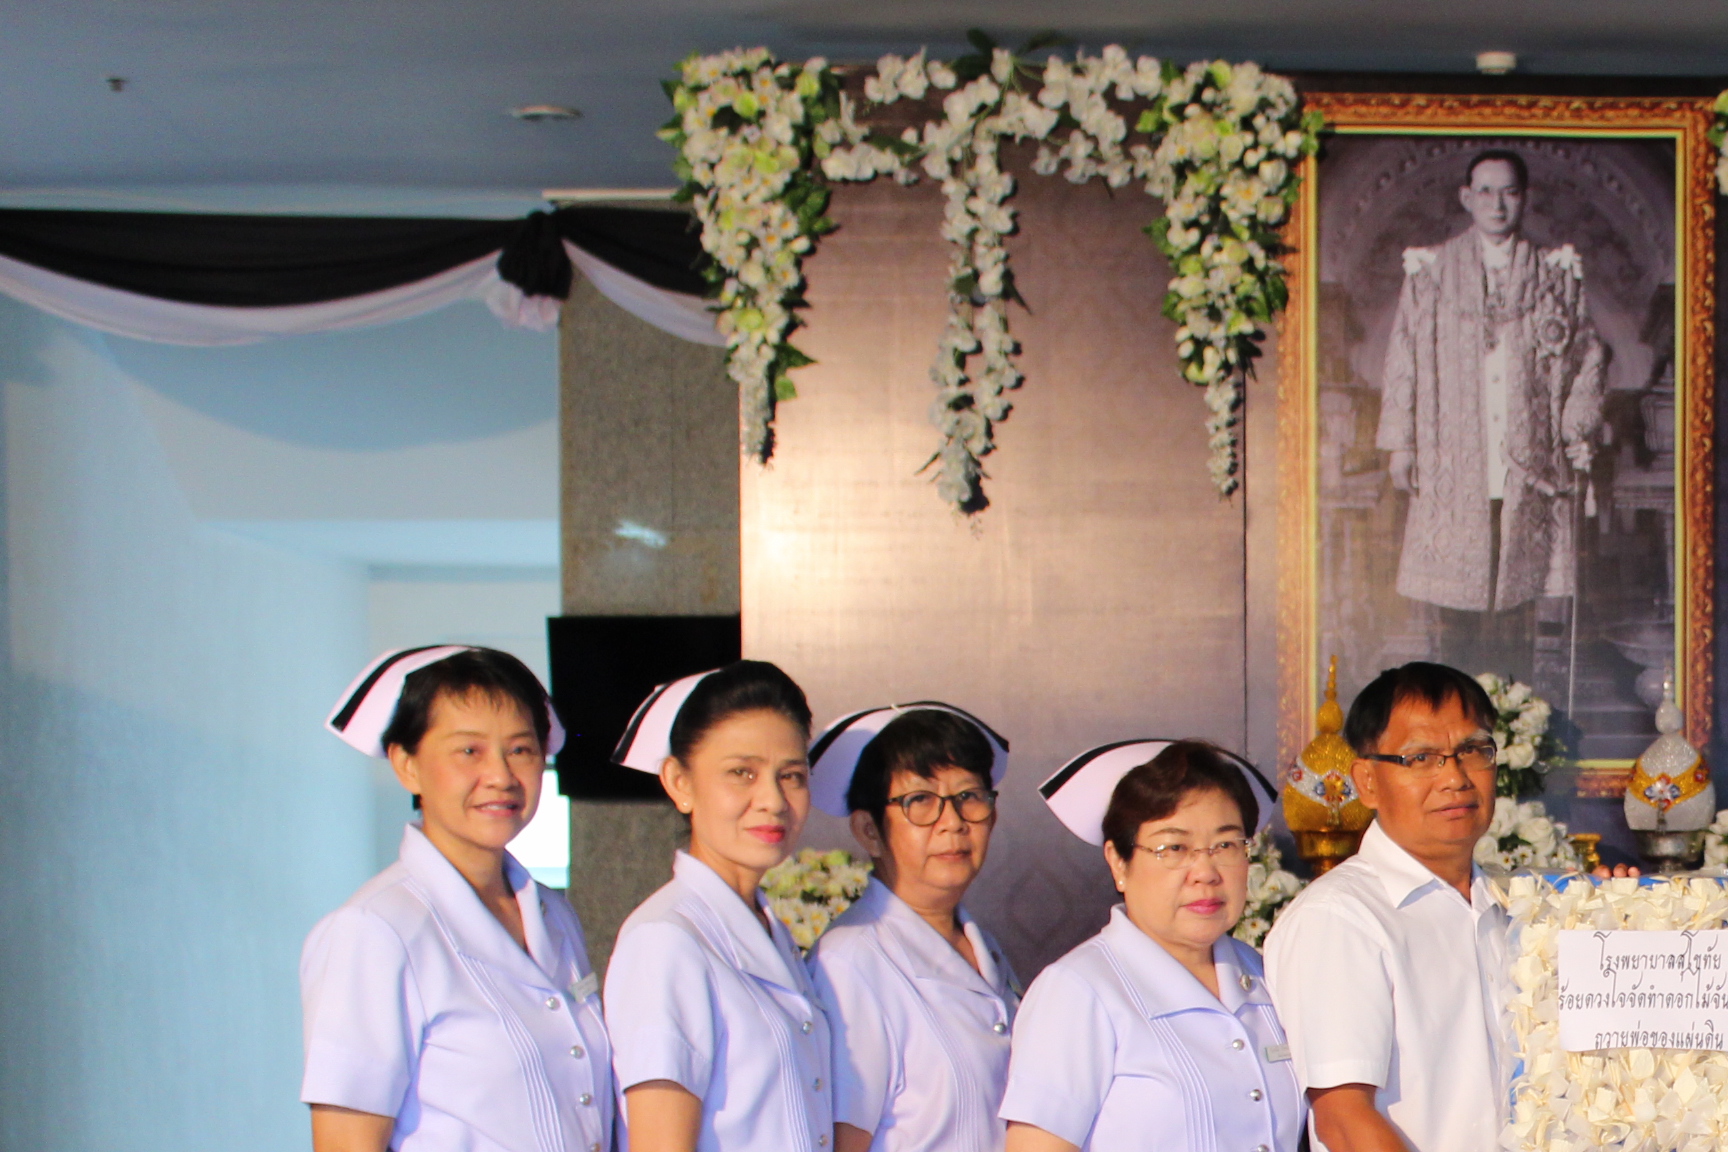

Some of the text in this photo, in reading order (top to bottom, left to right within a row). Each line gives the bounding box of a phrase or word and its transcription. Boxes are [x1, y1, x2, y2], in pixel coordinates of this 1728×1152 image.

[1593, 930, 1722, 982] โรงพยาบาลสุโขทัย
[1595, 1020, 1724, 1049] ถวายพ่อของแผ่นดิน
